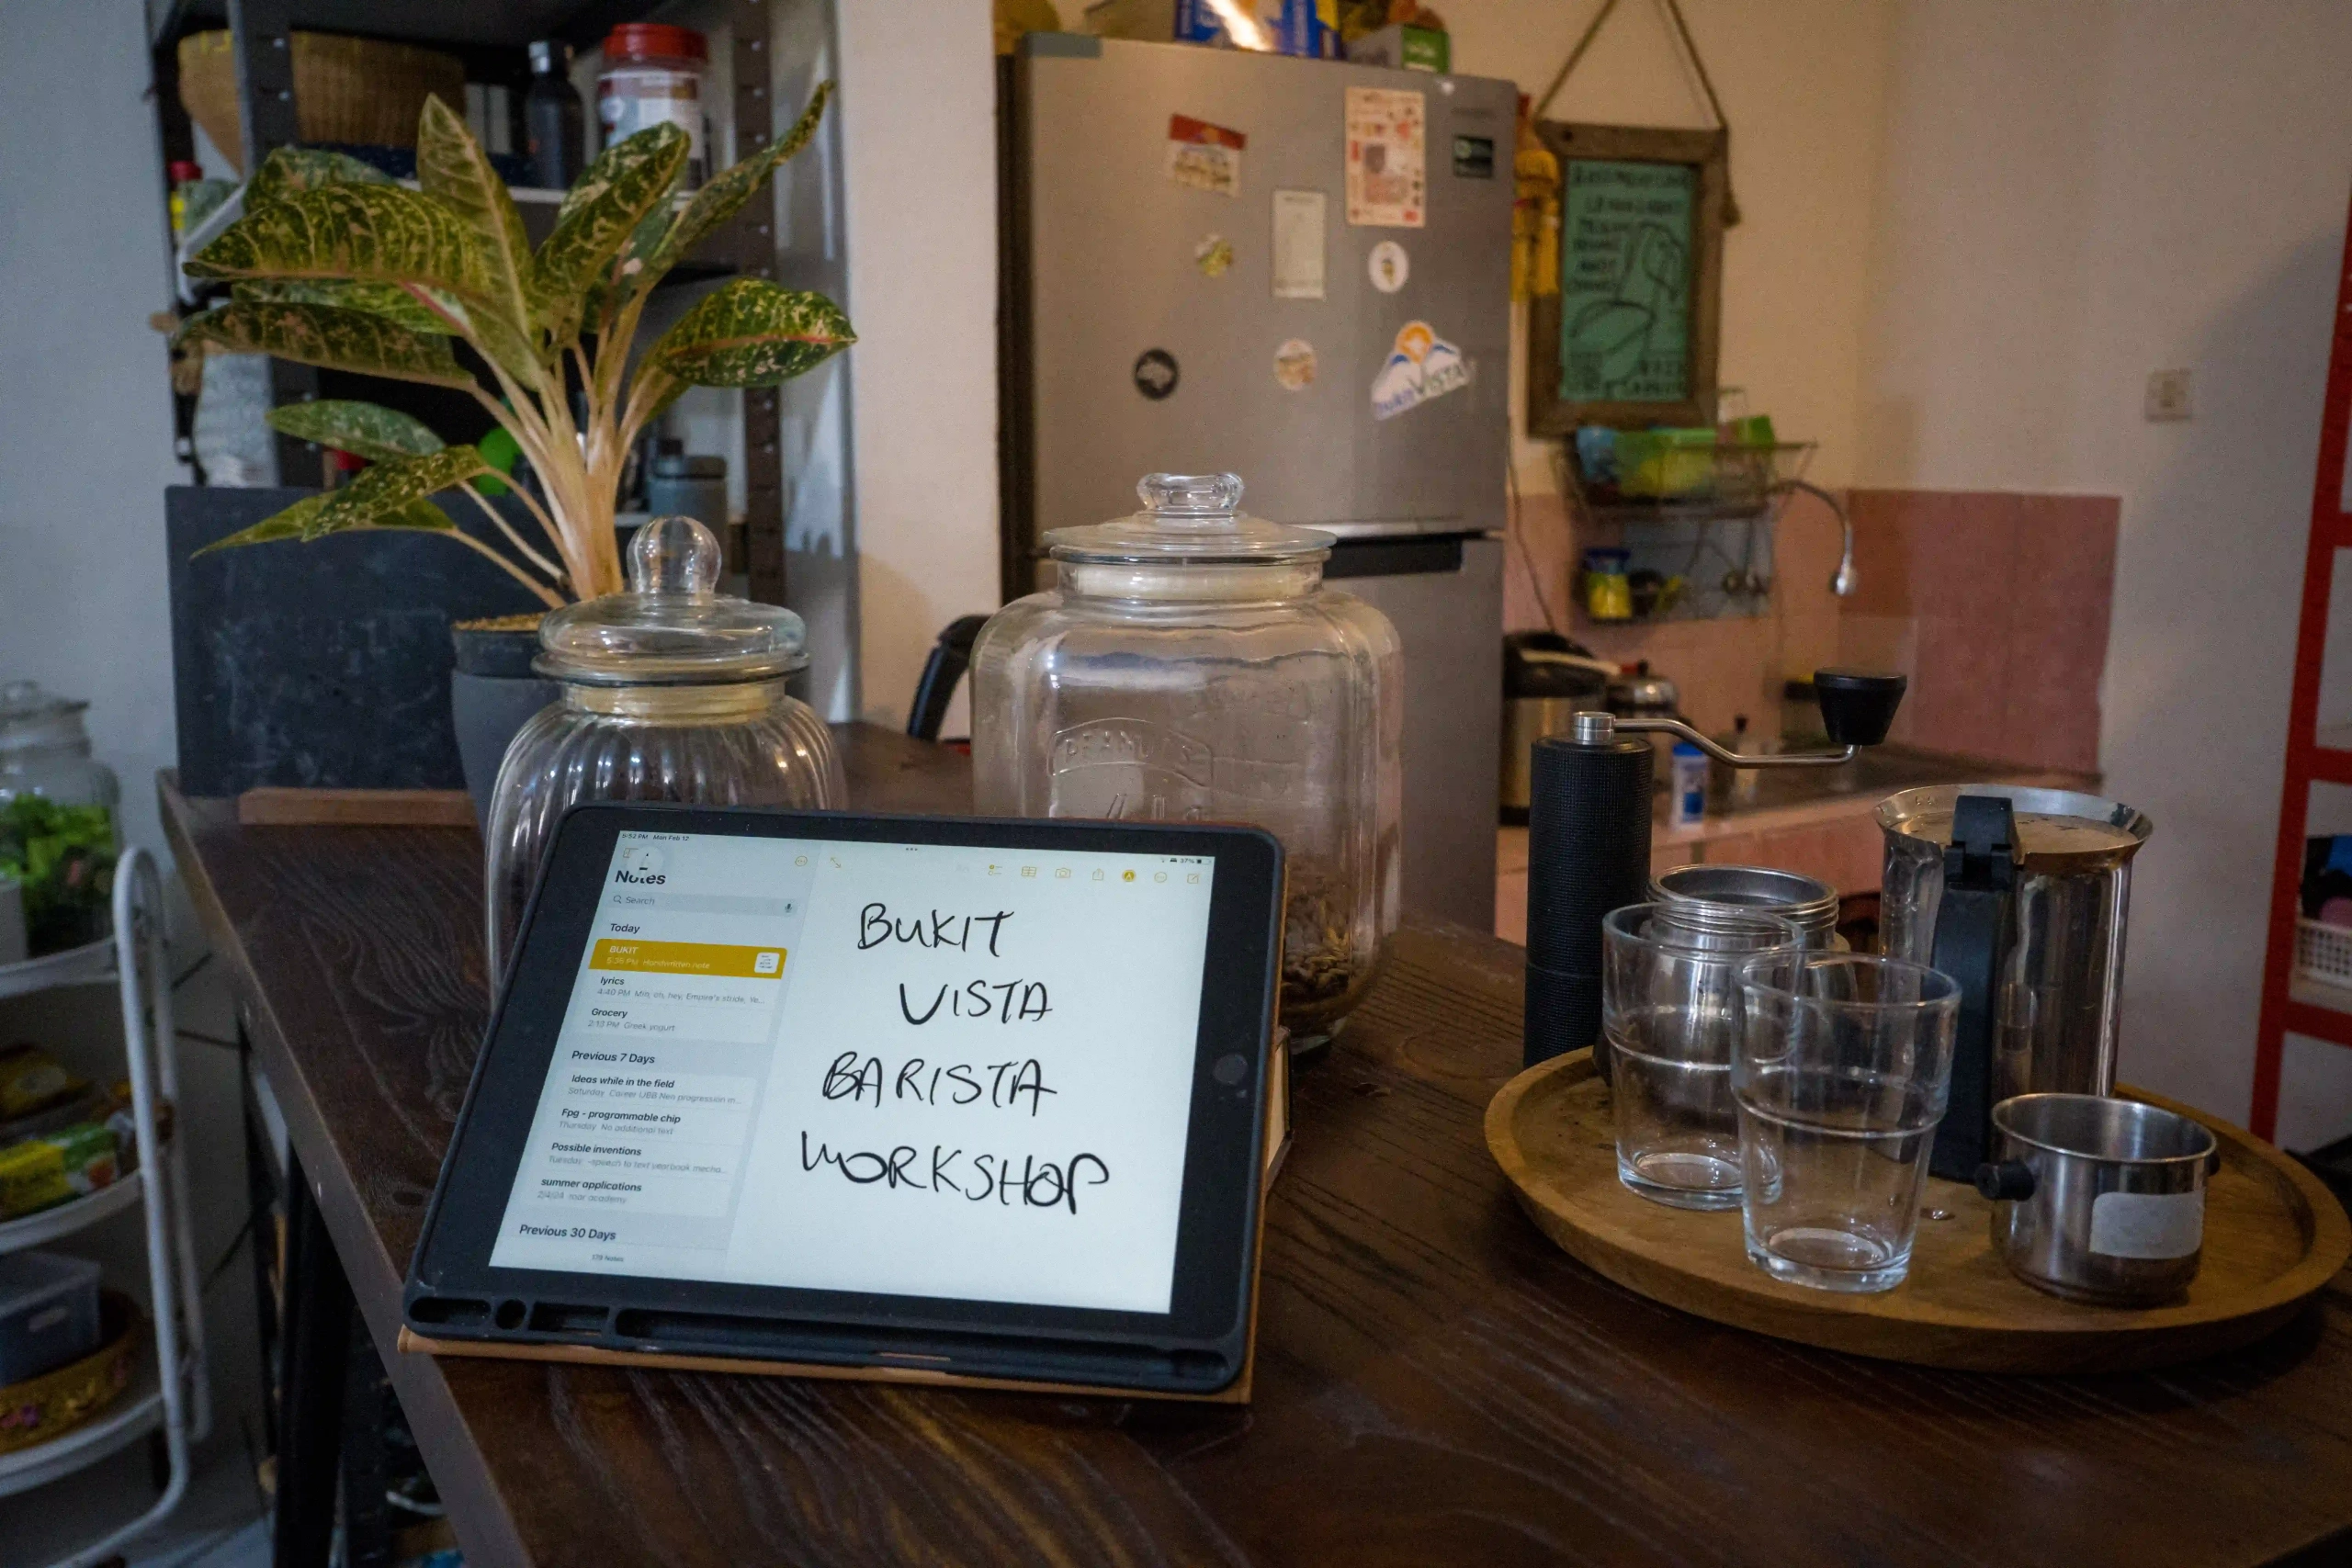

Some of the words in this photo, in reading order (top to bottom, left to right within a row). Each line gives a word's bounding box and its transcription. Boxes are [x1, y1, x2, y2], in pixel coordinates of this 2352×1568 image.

[625, 896, 655, 906] Search
[610, 923, 640, 934] Today
[857, 903, 1014, 957] BUKIT
[609, 945, 639, 955] BUKIT
[626, 957, 639, 965] PM
[643, 959, 691, 968] Handwritten
[692, 962, 710, 970] note
[600, 976, 625, 986] lyrics
[668, 992, 683, 1000] hey,
[686, 993, 720, 1002] Empire's
[722, 996, 746, 1004] stride,
[899, 979, 1053, 1025] VISTA
[591, 1008, 628, 1019] Grocery
[587, 1020, 605, 1028] 2:13
[606, 1021, 620, 1029] PM
[624, 1021, 647, 1031] Greek
[649, 1023, 675, 1032] yogurt
[571, 1050, 616, 1062] Previous
[620, 1053, 627, 1062] 7
[629, 1053, 655, 1064] Days
[571, 1075, 597, 1084] Ideas
[600, 1076, 624, 1086] while
[626, 1077, 634, 1086] in
[637, 1077, 651, 1087] the
[654, 1078, 674, 1089] field
[822, 1051, 1057, 1116] BARISTA
[568, 1087, 605, 1097] Saturday
[609, 1089, 636, 1099] Career
[677, 1094, 726, 1103] progression
[561, 1108, 580, 1119] Fpg
[588, 1111, 658, 1122] programmable
[660, 1113, 681, 1123] chip
[559, 1121, 597, 1132] Thursday
[601, 1122, 613, 1132] No
[615, 1123, 656, 1134] additional
[657, 1126, 673, 1135] text
[551, 1142, 592, 1154] Possible
[593, 1144, 642, 1156] inventions
[548, 1156, 582, 1165] Tuesday
[624, 1160, 632, 1168] to
[634, 1161, 650, 1169] text
[651, 1162, 690, 1171] yearbook
[801, 1130, 1109, 1214] WORKSHOP
[540, 1178, 581, 1189] summer
[582, 1180, 642, 1192] applications
[569, 1192, 586, 1201] roar
[588, 1195, 628, 1204] academy
[519, 1224, 568, 1238] Previous
[570, 1226, 586, 1238] 30
[588, 1228, 616, 1242] Days
